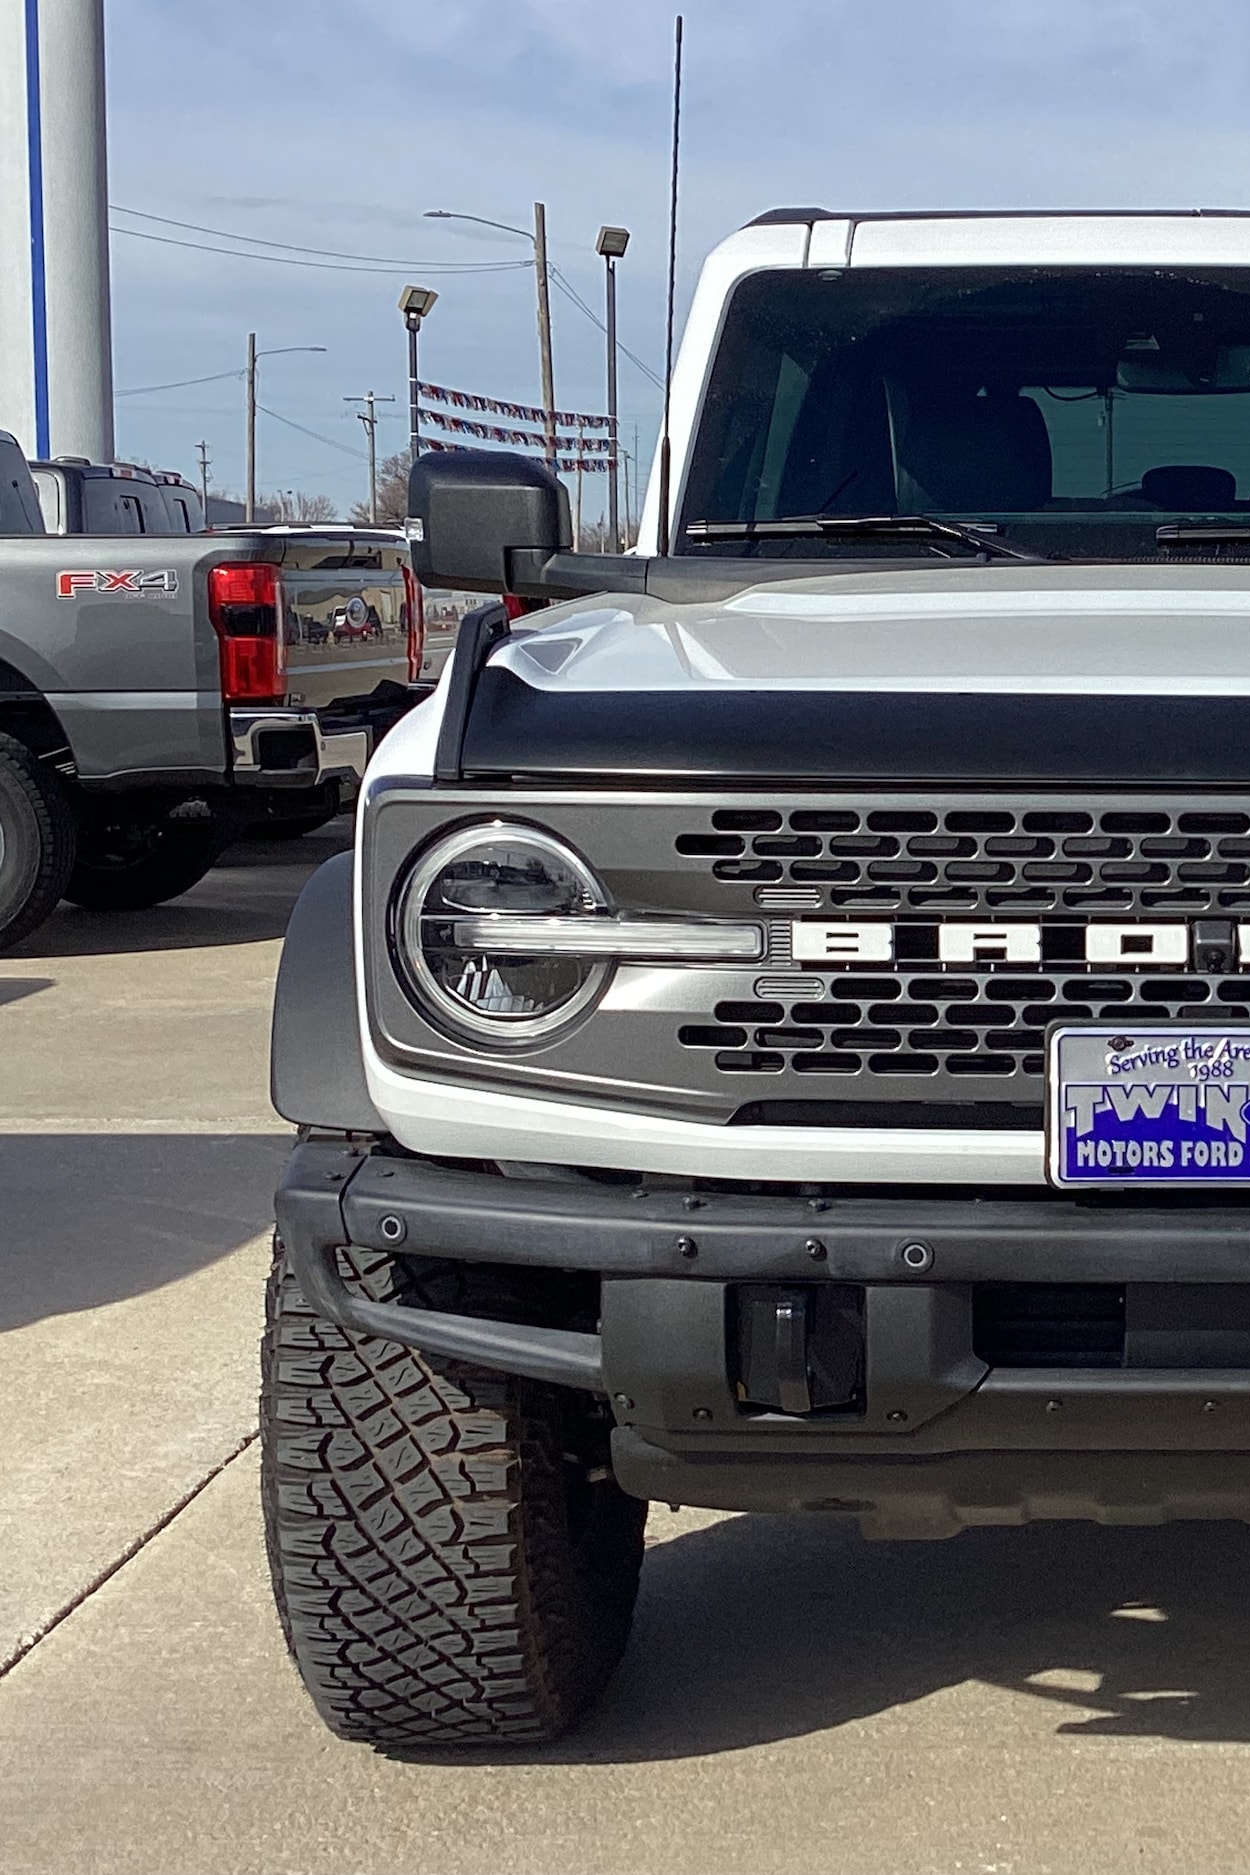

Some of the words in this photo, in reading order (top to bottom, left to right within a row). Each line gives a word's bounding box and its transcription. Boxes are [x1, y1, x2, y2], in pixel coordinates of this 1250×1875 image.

[57, 569, 178, 599] FX4
[1108, 1045, 1180, 1076] Serving
[1183, 1037, 1214, 1060] the
[1190, 1060, 1235, 1082] 1988
[1064, 1083, 1248, 1145] TWIN
[1076, 1140, 1175, 1168] MOTORS
[1181, 1140, 1245, 1168] FORD
